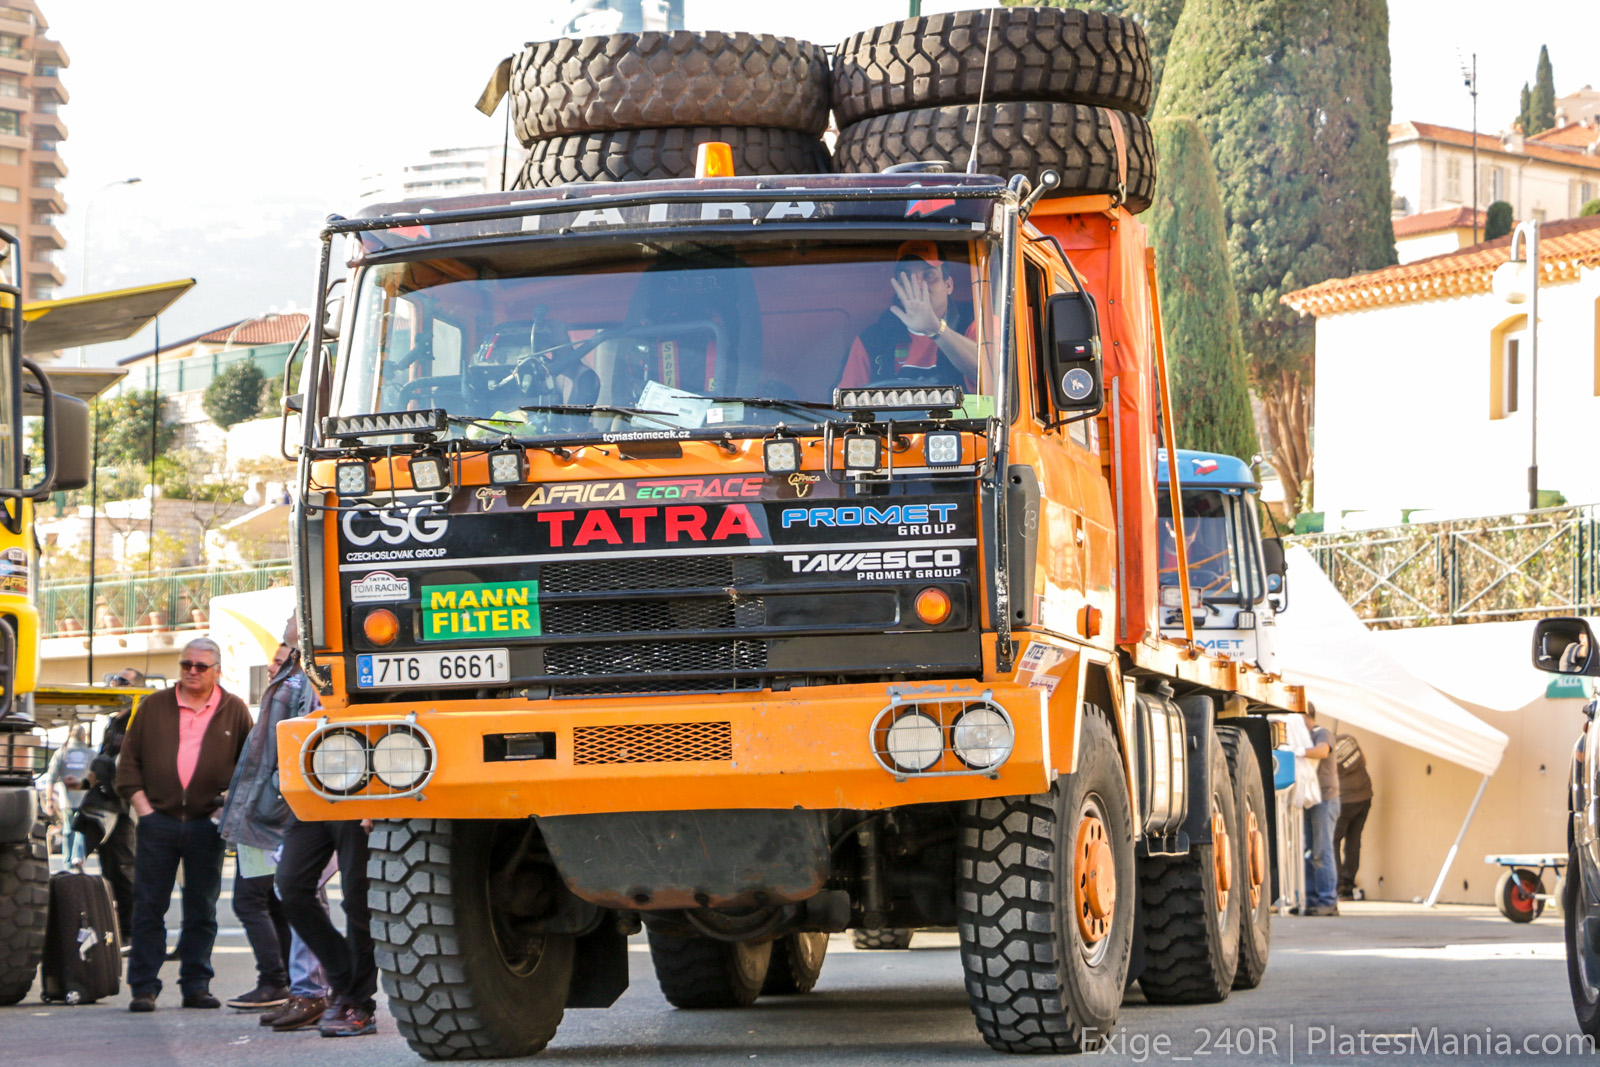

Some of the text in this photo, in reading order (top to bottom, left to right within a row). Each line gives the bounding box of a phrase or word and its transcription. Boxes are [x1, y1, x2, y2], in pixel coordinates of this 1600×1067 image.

[522, 482, 626, 510] AFRICA
[342, 499, 449, 547] CSG
[537, 503, 763, 547] TATRA
[781, 503, 958, 529] PROMET
[898, 523, 956, 536] GROUP
[346, 548, 447, 562] CZECHOSLOVAK GROUP
[783, 549, 961, 573] TAWESCO
[857, 568, 962, 581] PROMET GROUP
[352, 583, 407, 593] TOM RACING
[430, 587, 529, 610] MANN
[432, 609, 531, 634] FILTER
[360, 654, 495, 683] CZ 7T6 6661
